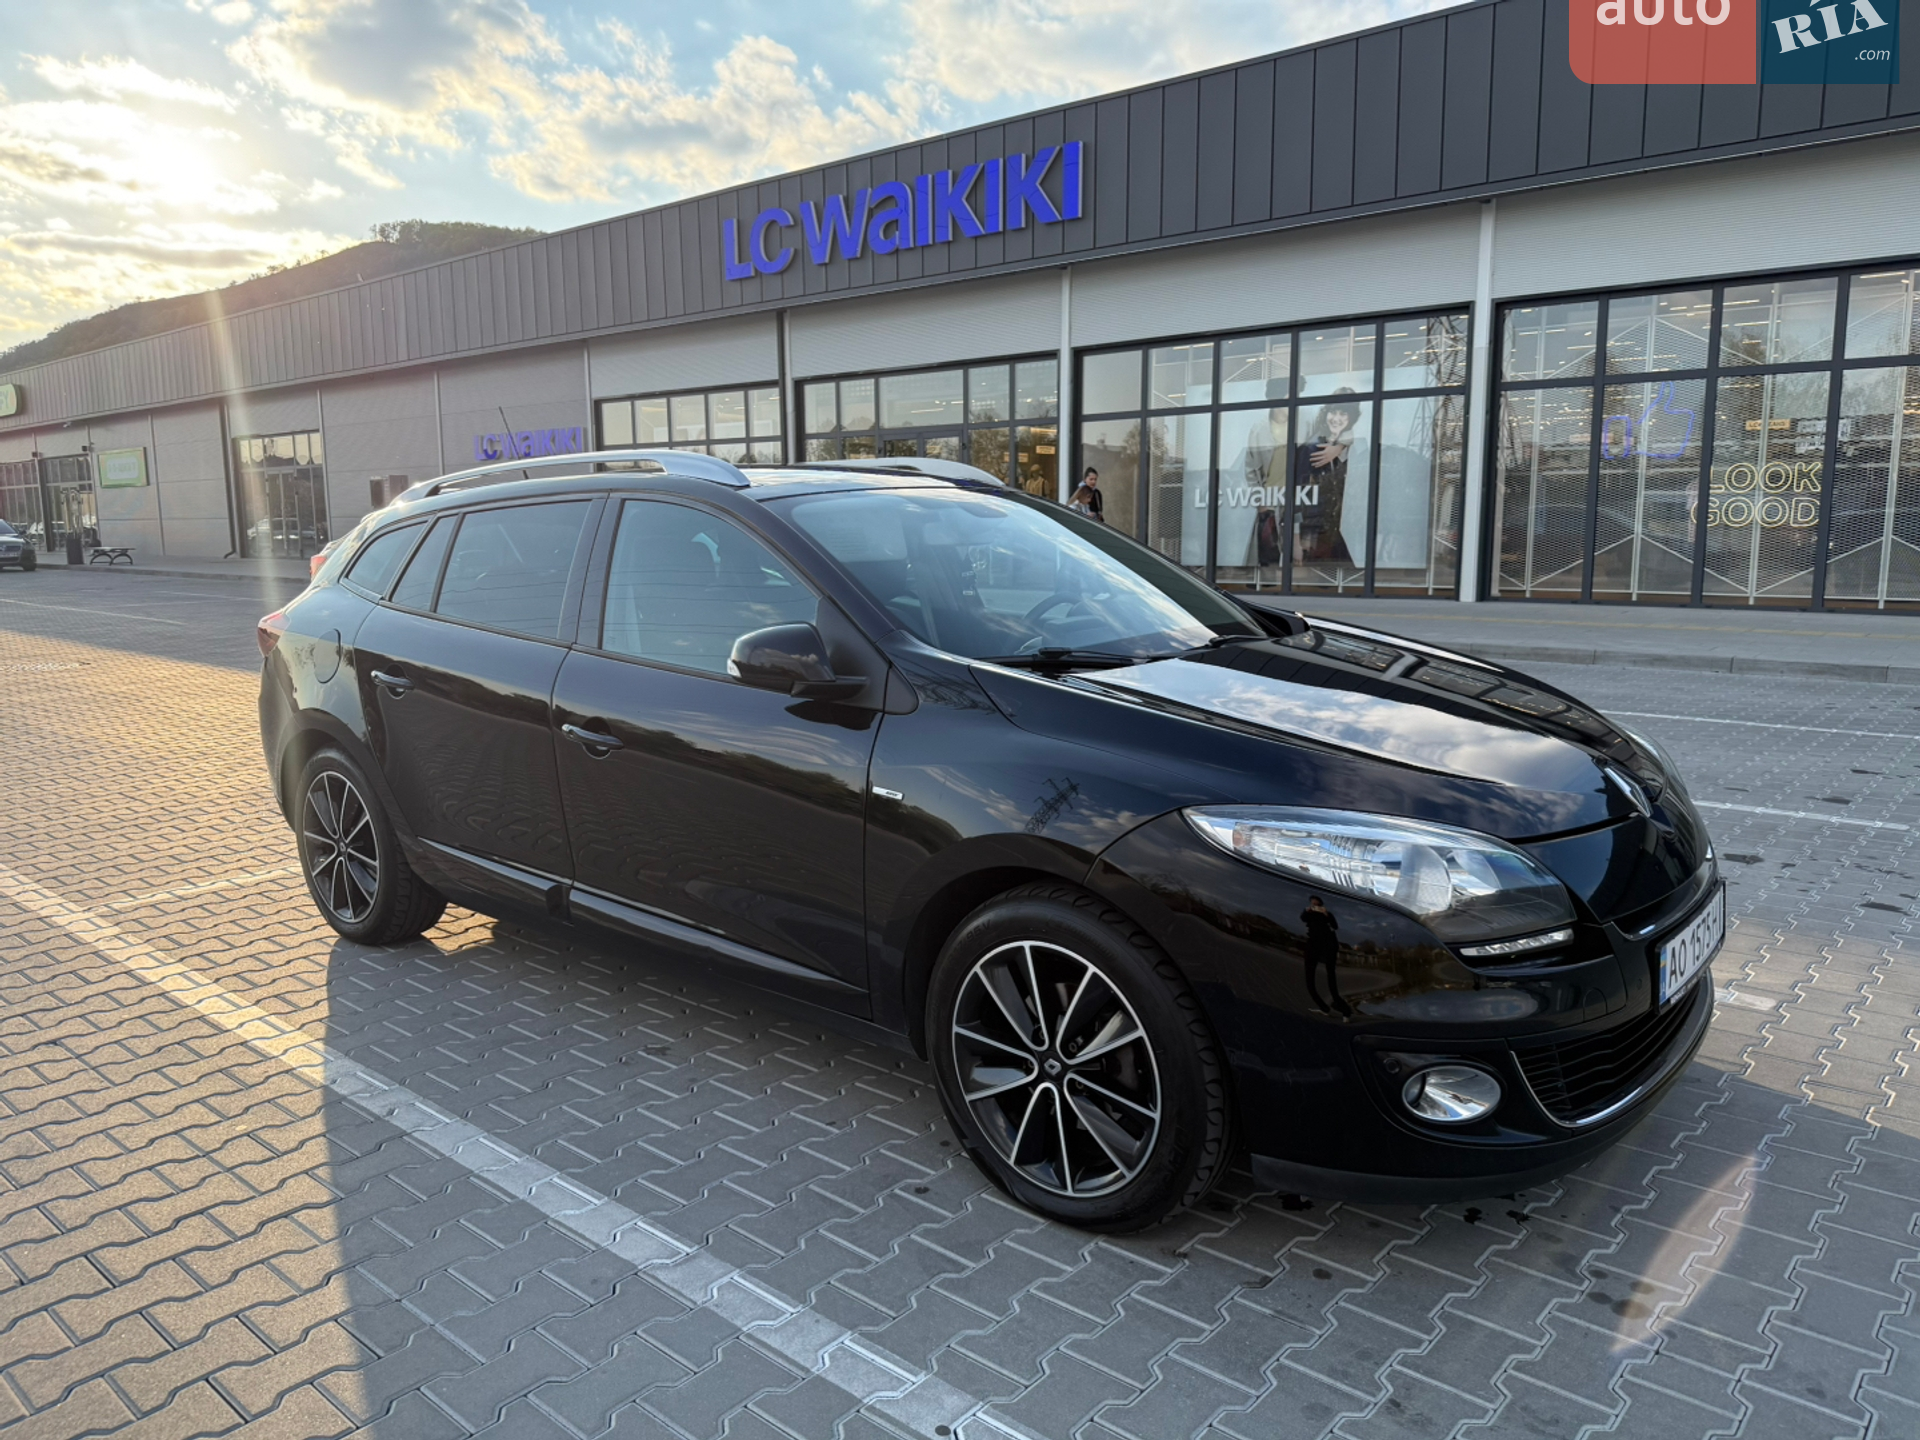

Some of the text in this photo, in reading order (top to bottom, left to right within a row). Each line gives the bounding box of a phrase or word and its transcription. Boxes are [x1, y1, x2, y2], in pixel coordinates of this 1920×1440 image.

[723, 207, 796, 282] LC
[474, 433, 498, 462] LC
[1690, 497, 1821, 528] GOOD
[1668, 938, 1687, 989] AO
[1690, 911, 1711, 967] 1575
